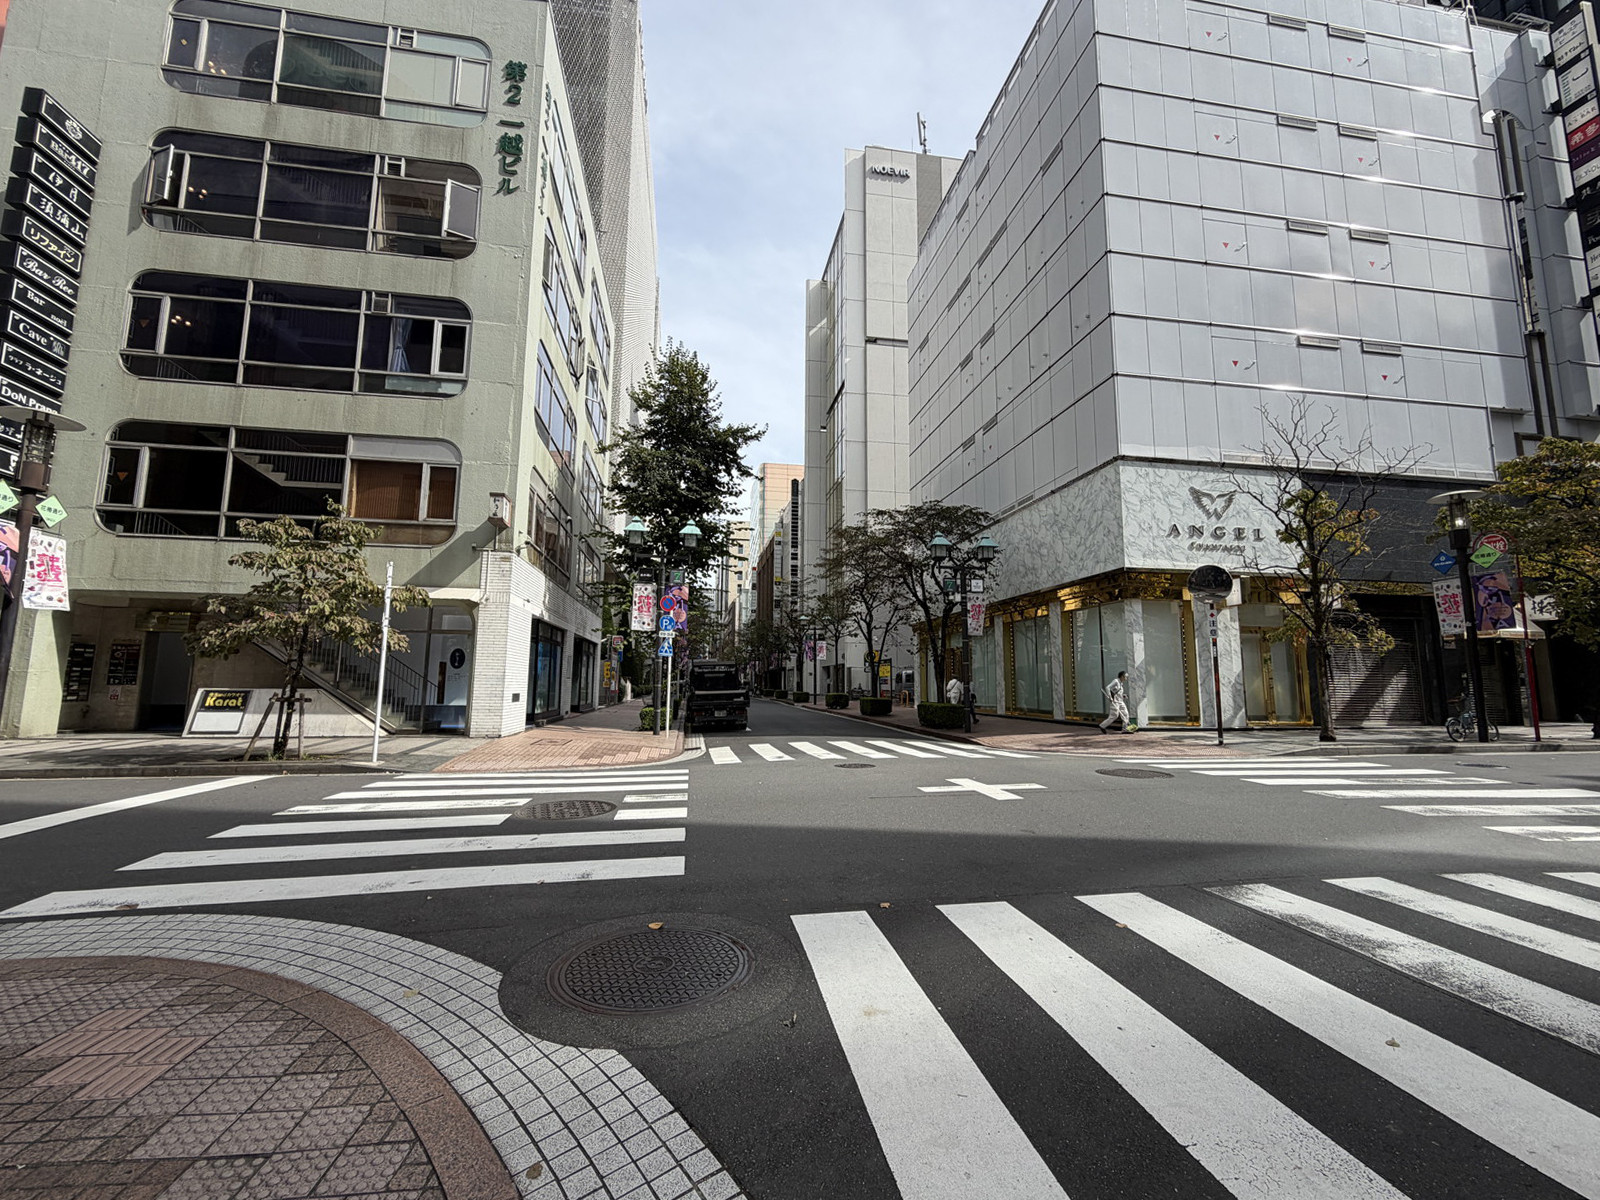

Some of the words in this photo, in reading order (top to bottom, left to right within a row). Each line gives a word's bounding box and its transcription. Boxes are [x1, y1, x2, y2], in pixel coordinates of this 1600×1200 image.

[872, 165, 911, 178] NOEVIR
[26, 290, 46, 307] Bar
[18, 322, 48, 346] Cave
[1167, 523, 1265, 541] ANGEL
[205, 696, 243, 706] Karat
